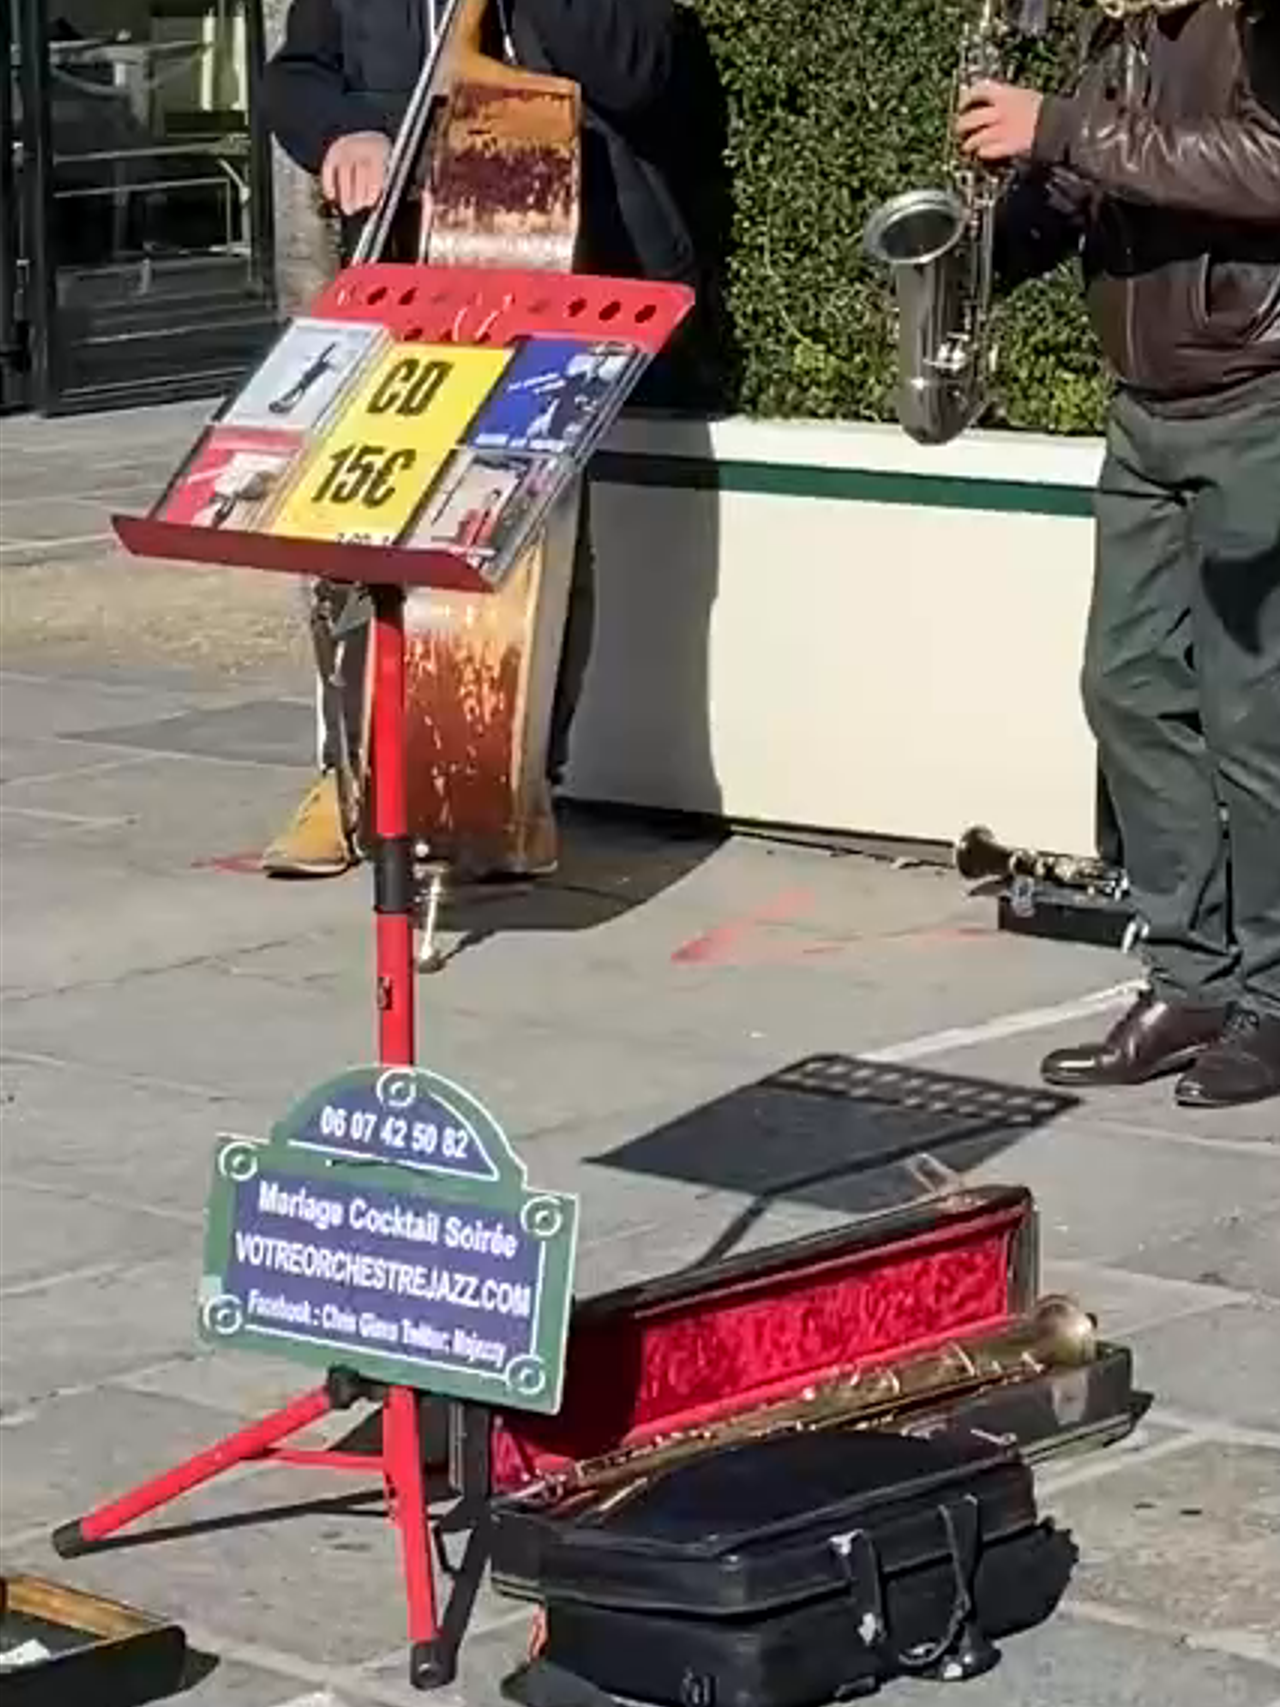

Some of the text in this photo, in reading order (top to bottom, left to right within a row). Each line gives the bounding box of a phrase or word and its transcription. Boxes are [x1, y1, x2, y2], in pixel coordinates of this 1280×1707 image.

[366, 357, 454, 416] CD
[311, 444, 417, 509] 15€
[320, 1104, 469, 1159] 06 07 42 50 82
[258, 1180, 519, 1260] Mariage Cocktail Soirée
[235, 1231, 531, 1319] VOTREORCHESTREJAZZ.COM
